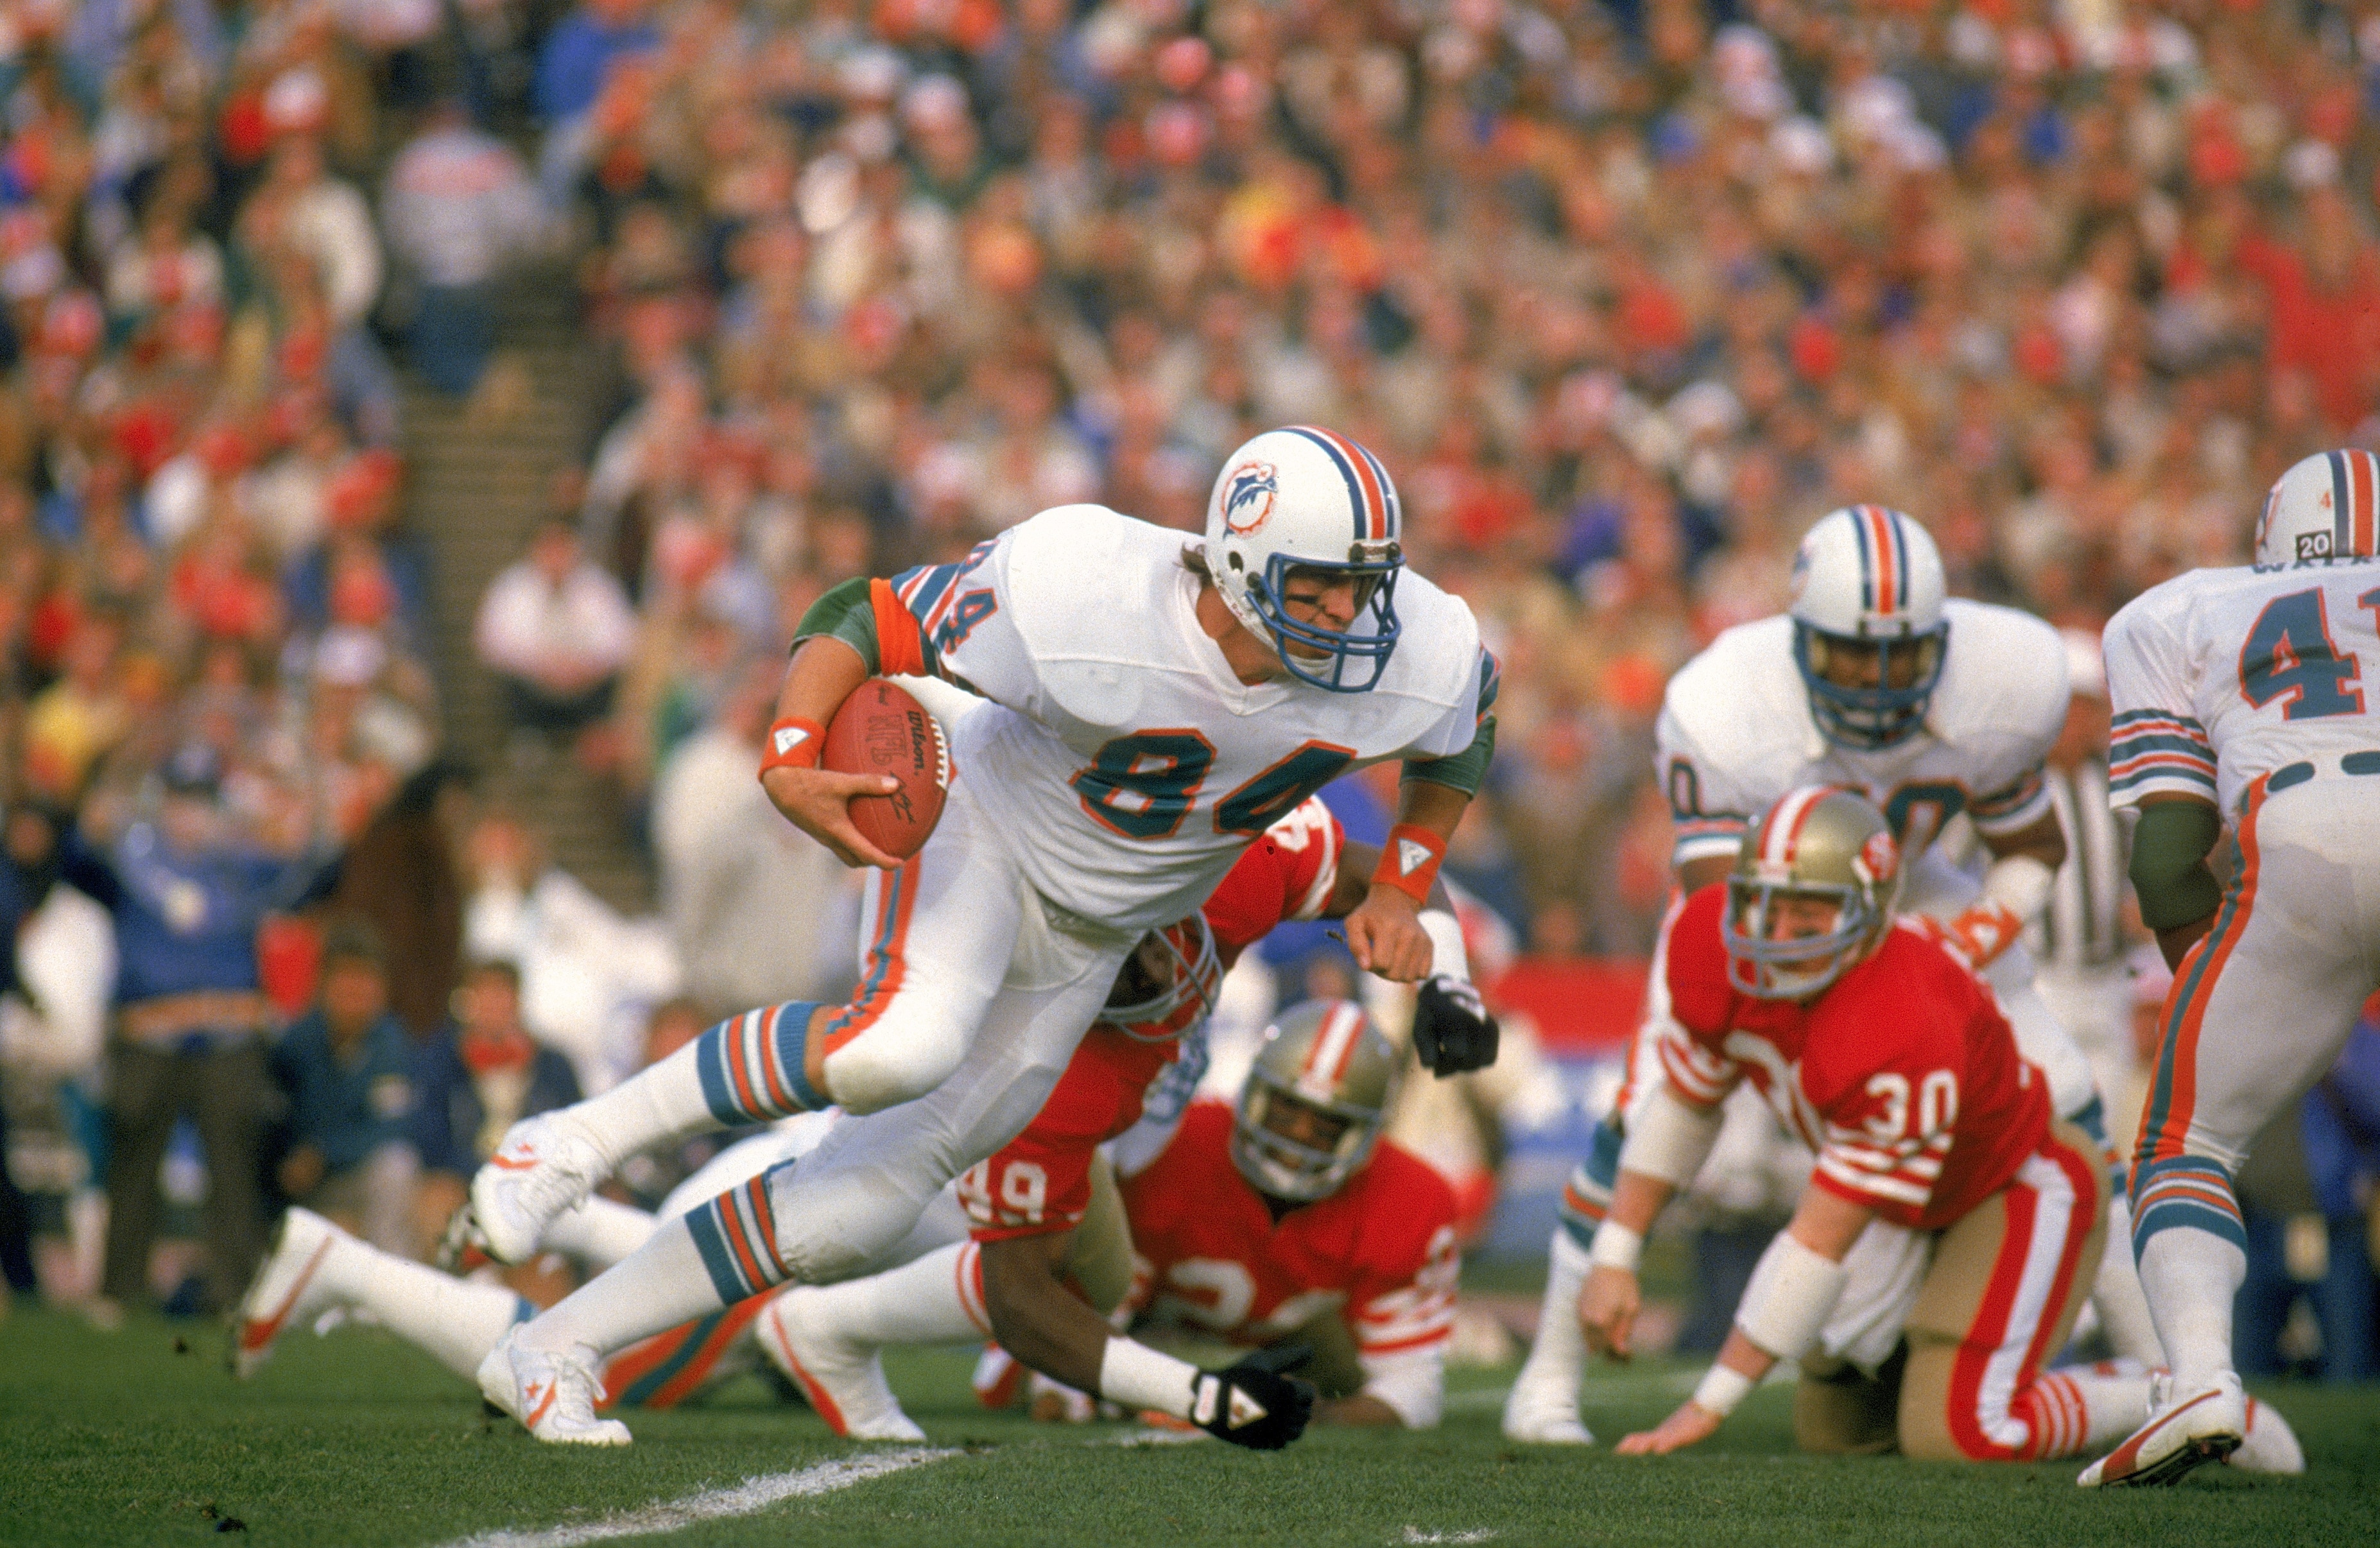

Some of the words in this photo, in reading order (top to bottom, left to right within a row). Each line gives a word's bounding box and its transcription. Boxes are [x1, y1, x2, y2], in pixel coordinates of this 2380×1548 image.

[2298, 533, 2330, 559] 20
[2238, 585, 2380, 721] 4
[906, 710, 927, 770] Wilson
[1068, 727, 1358, 839] 84
[1863, 1069, 1959, 1144] 30
